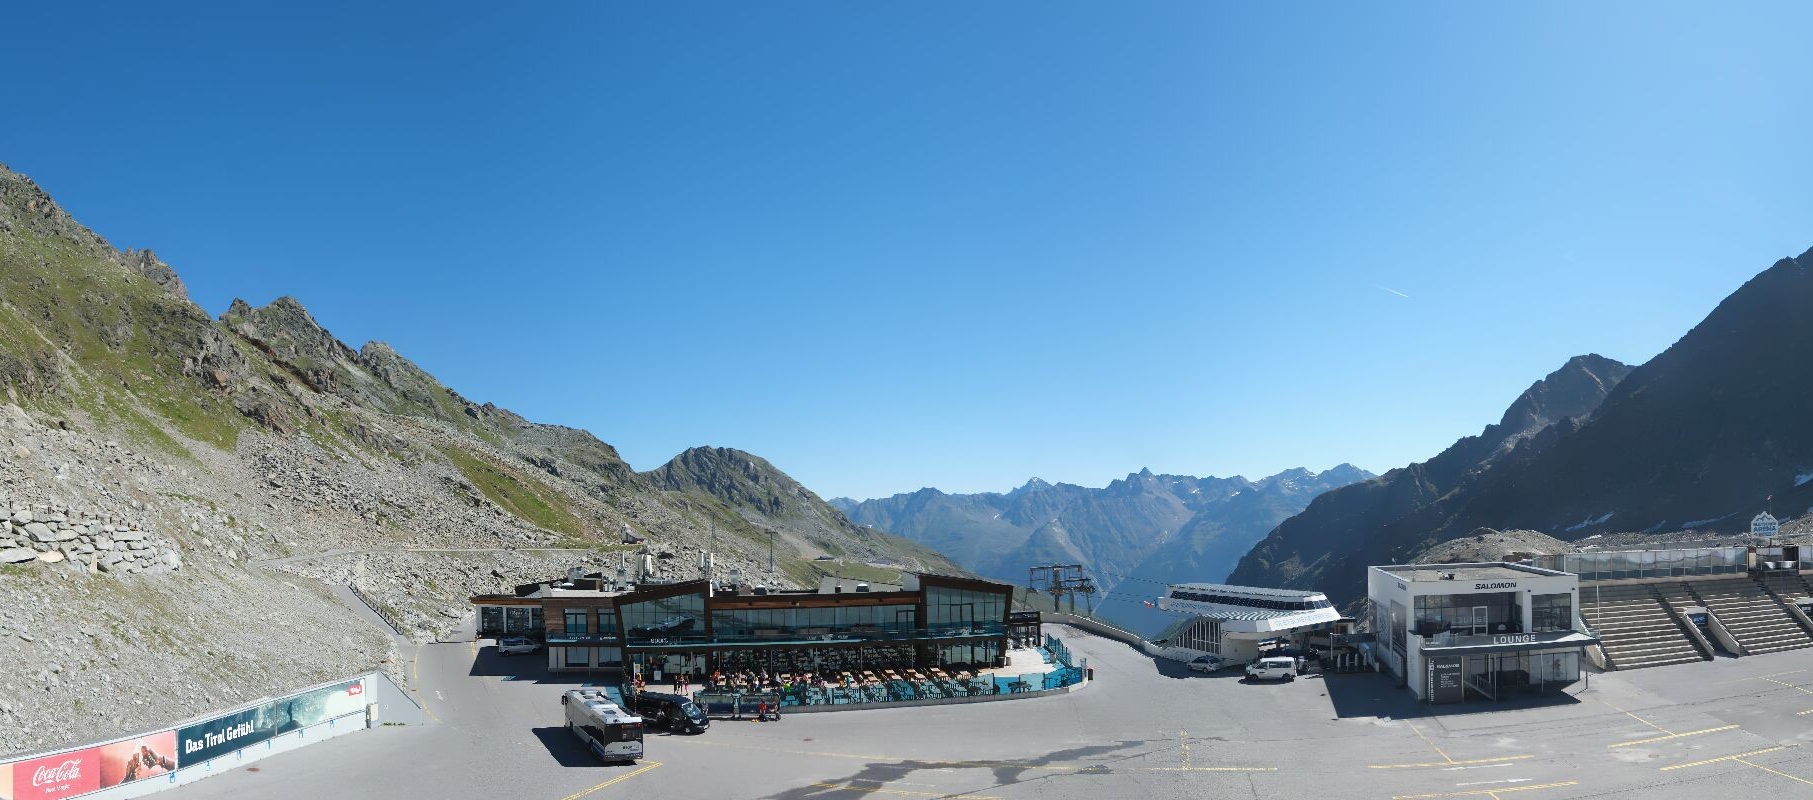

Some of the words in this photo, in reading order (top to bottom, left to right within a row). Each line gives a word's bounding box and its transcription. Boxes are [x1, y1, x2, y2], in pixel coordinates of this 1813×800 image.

[1474, 582, 1517, 590] SALOMON
[1493, 634, 1536, 644] LOUNGE
[185, 738, 204, 755] Das
[204, 728, 226, 748] Tirol
[226, 719, 255, 741] Gefühl
[32, 759, 82, 787] Coca-Cola
